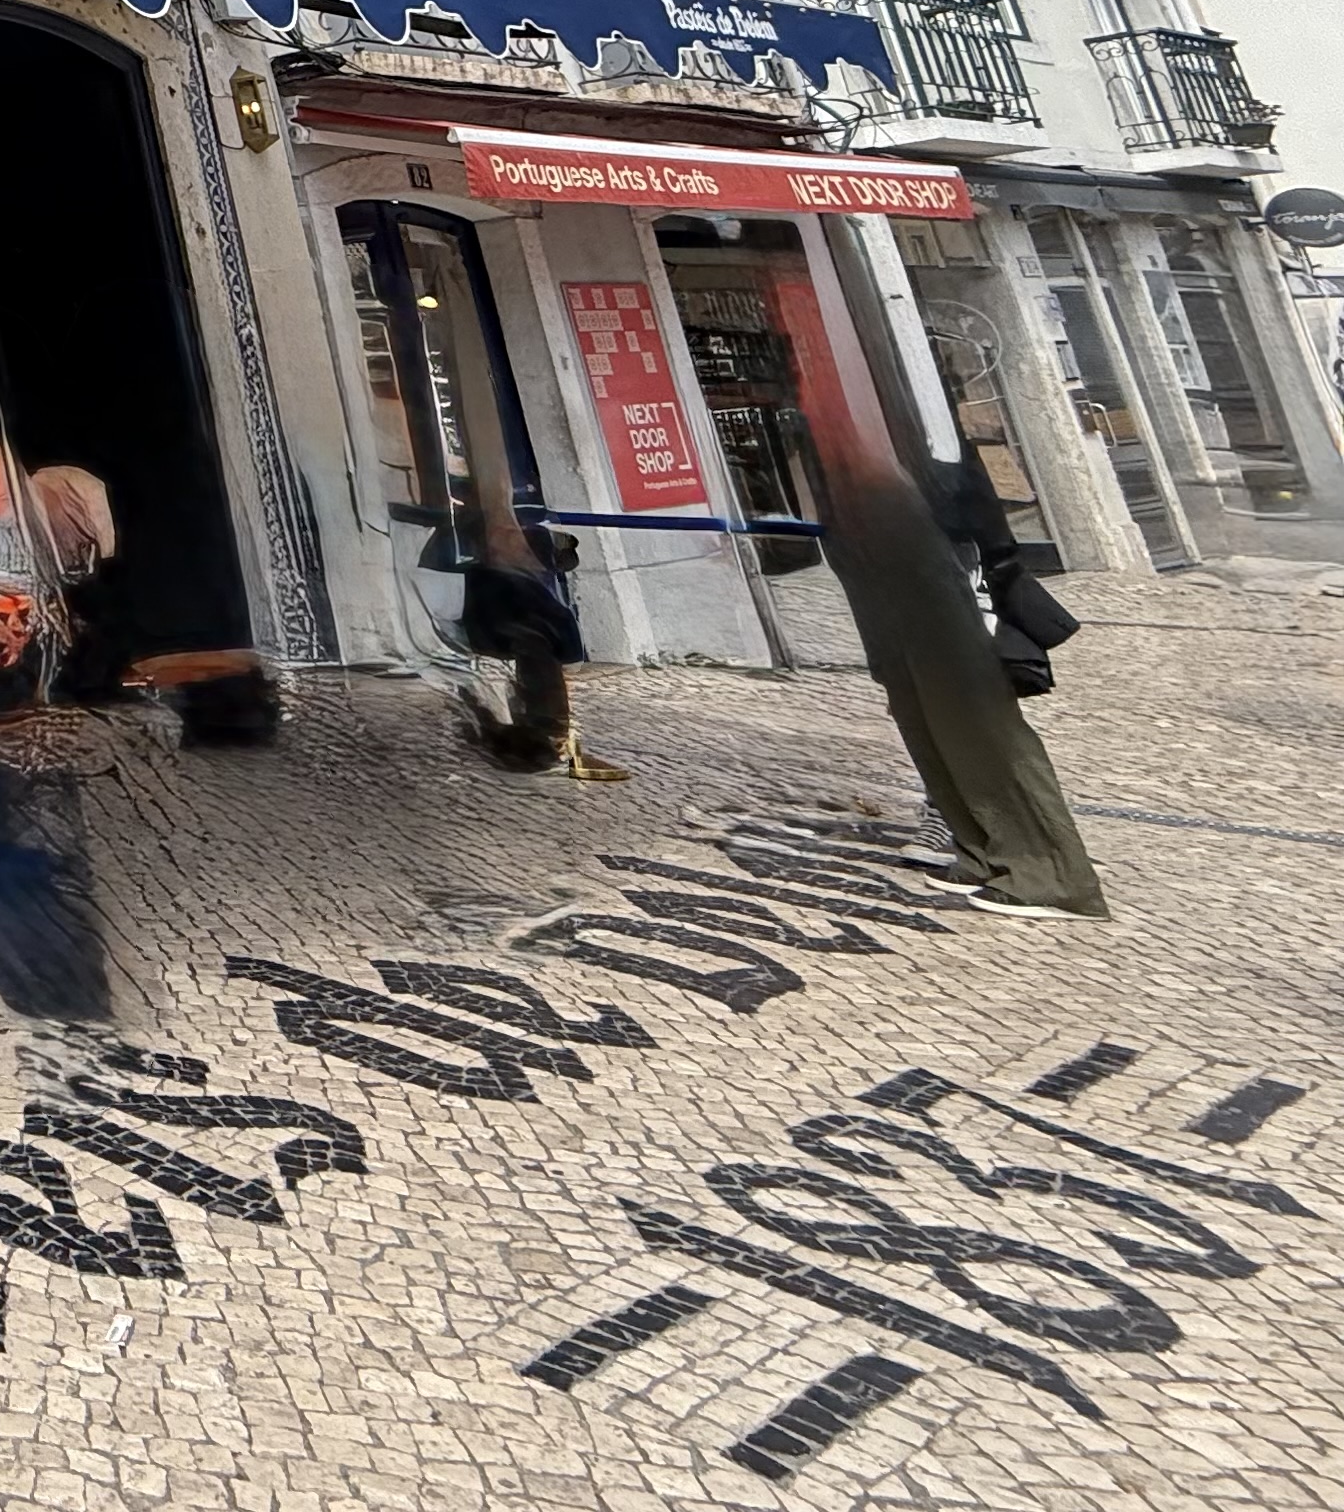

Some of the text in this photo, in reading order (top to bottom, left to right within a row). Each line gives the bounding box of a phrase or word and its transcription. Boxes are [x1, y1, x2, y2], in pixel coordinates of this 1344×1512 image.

[716, 5, 736, 36] de
[489, 154, 605, 193] Portuguese
[607, 165, 647, 192] Arts
[648, 169, 663, 193] &
[664, 167, 720, 196] Crafts
[787, 174, 852, 206] NEXT
[847, 176, 912, 208] DOOR
[905, 179, 957, 210] SHOP
[622, 403, 662, 426] NEXT
[629, 428, 669, 450] DOOR
[635, 451, 675, 475] SHOP
[616, 1067, 1321, 1421] 1837
